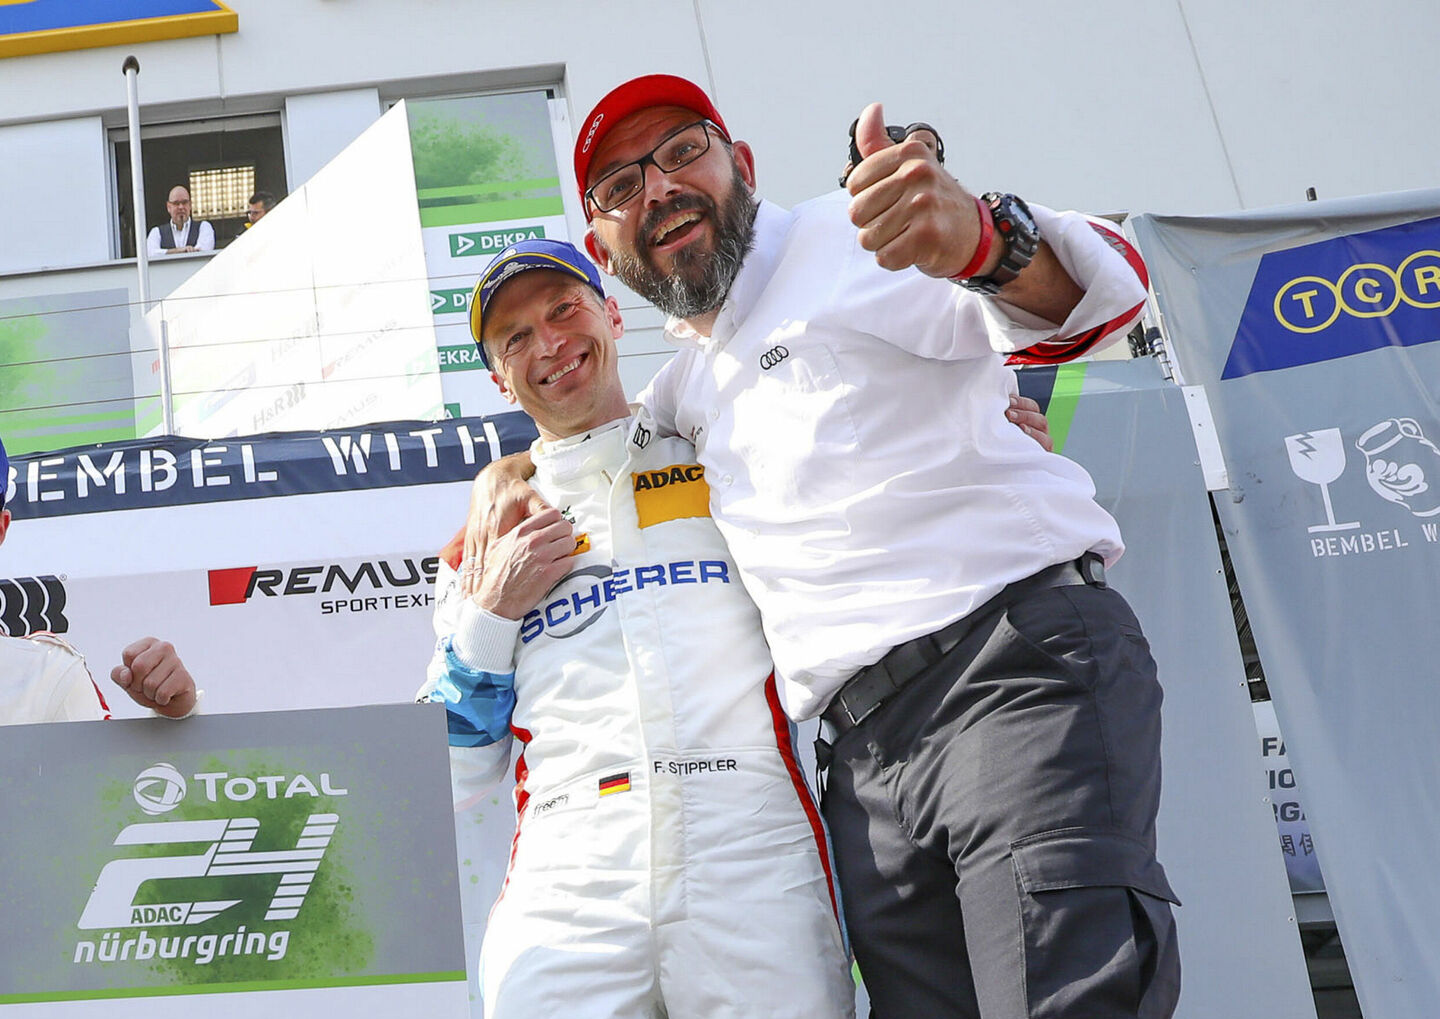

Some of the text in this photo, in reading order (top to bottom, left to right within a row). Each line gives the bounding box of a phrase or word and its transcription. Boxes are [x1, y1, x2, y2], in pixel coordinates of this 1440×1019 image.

[321, 421, 502, 475] WITH
[635, 465, 705, 491] ADAC
[1311, 527, 1409, 557] BEMBEL
[520, 560, 730, 644] SCHERER
[654, 759, 738, 776] F. STIPPLER
[193, 772, 348, 802] TOTAL
[77, 813, 340, 930] 24
[131, 905, 182, 924] ADAC
[73, 925, 290, 965] nürburgring
